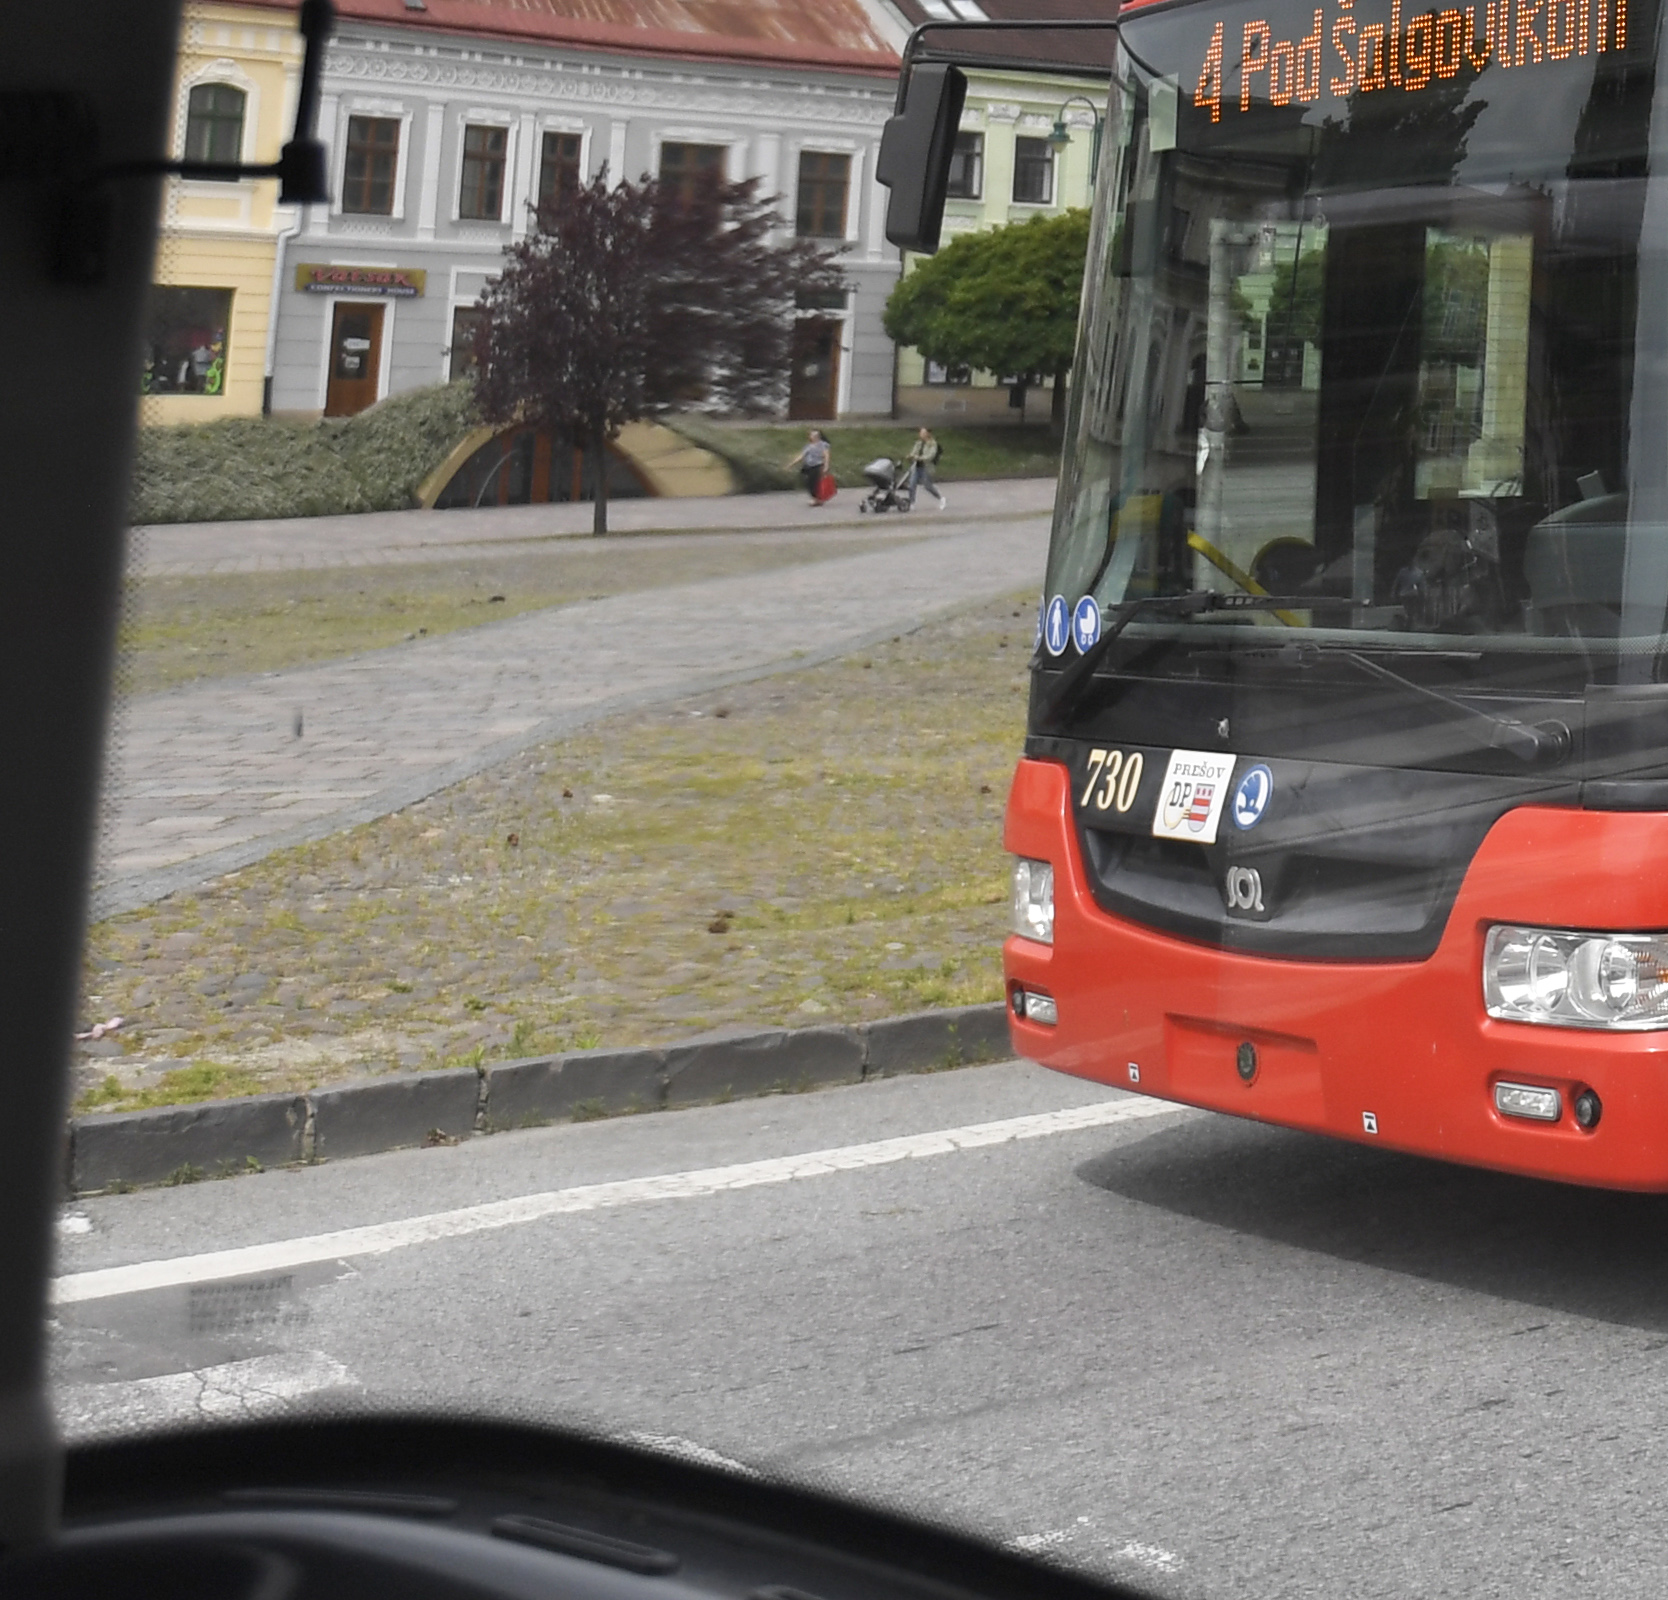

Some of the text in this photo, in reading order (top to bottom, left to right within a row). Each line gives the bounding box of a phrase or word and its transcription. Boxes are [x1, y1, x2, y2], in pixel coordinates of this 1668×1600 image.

[1193, 20, 1224, 124] 4
[1239, 7, 1324, 113] Pod
[1080, 748, 1143, 812] 730
[1173, 761, 1226, 778] PREŠOV
[1169, 781, 1192, 807] DP
